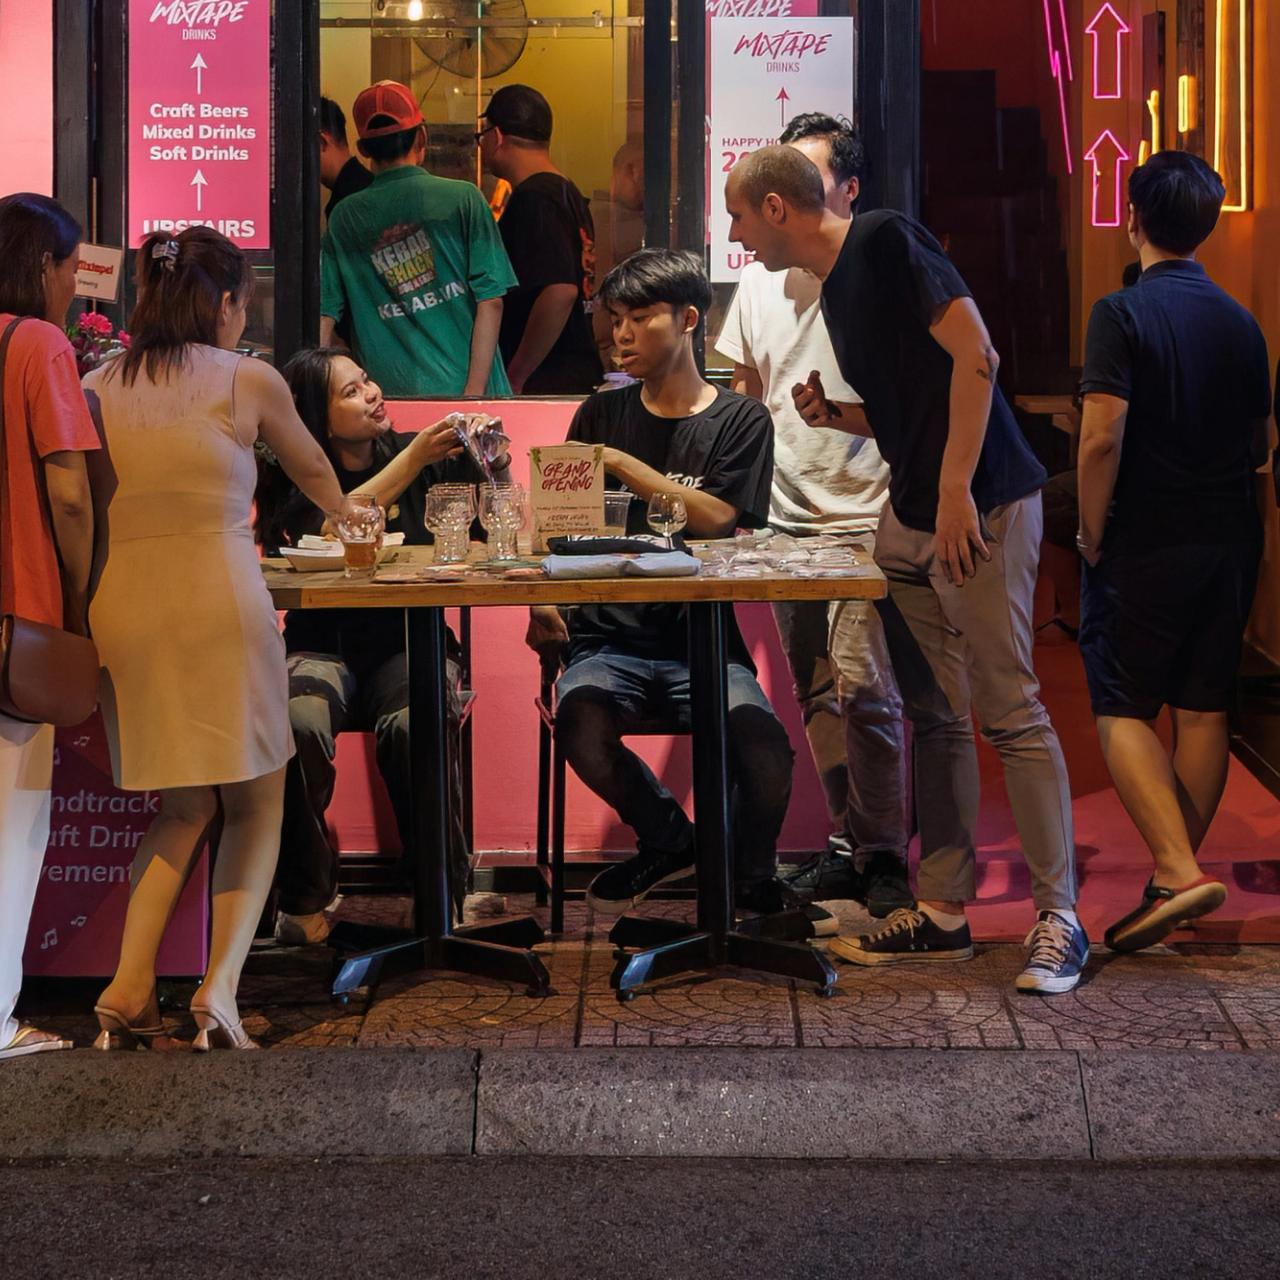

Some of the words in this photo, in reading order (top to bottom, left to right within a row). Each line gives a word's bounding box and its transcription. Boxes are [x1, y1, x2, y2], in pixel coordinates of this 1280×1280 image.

[182, 29, 216, 40] DRINKS
[766, 62, 800, 73] DRINKS
[150, 103, 195, 118] Craft
[200, 103, 249, 118] Beers
[143, 124, 194, 139] Mixed
[199, 124, 256, 139] Drinks
[722, 137, 762, 147] HAPPY
[150, 145, 187, 161] Soft
[191, 145, 249, 161] Drinks
[378, 282, 465, 320] KEAB.VN
[543, 460, 592, 479] GRAND
[542, 474, 593, 493] OPENING
